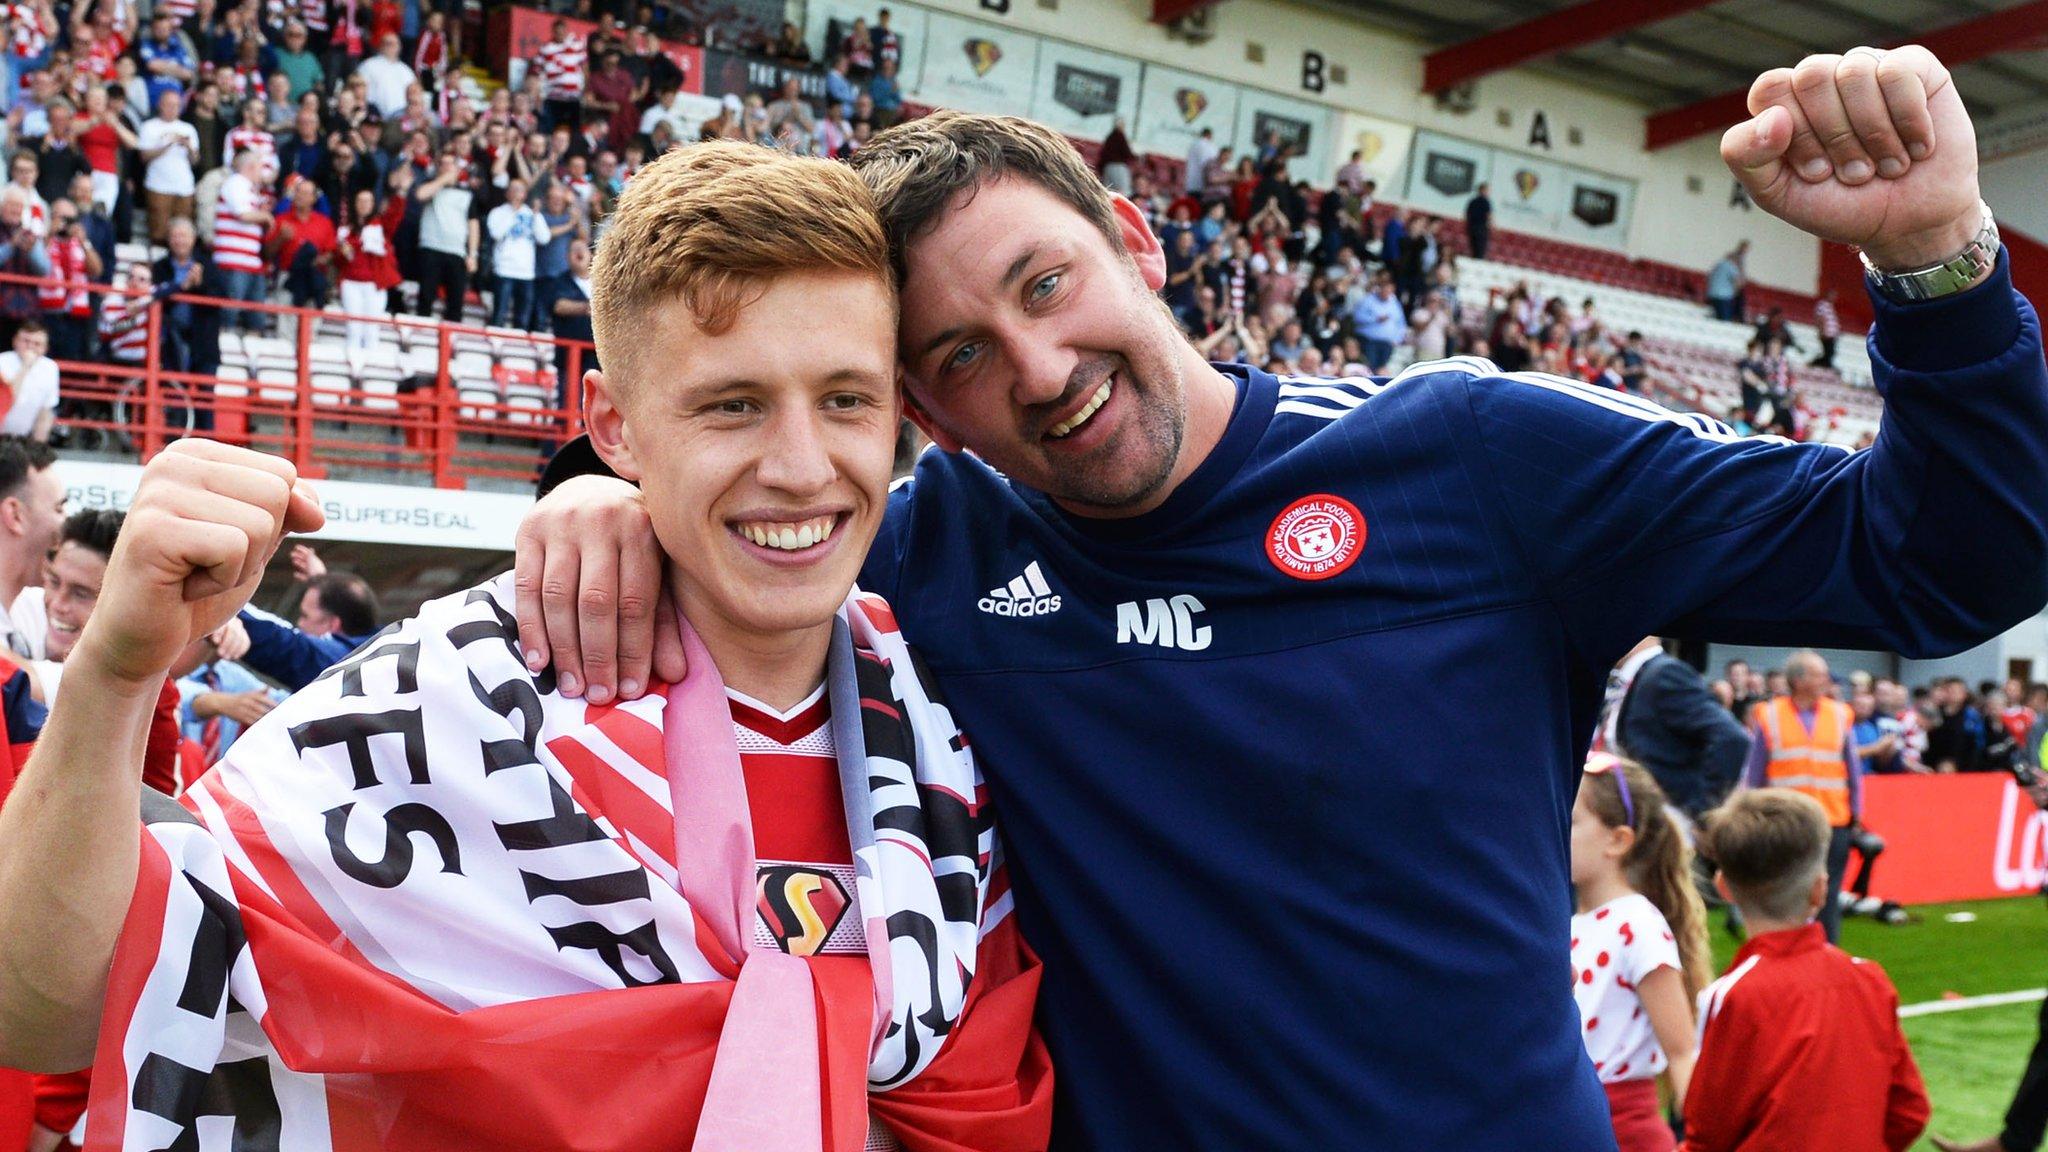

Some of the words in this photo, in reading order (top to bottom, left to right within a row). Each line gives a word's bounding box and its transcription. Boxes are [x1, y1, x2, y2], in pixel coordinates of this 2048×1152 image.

[1302, 50, 1324, 93] B
[1529, 110, 1552, 150] A
[1273, 502, 1322, 541] ACADEMICAL
[1323, 502, 1357, 537] FOOTBALL
[1272, 542, 1312, 573] HAMILTON
[1312, 560, 1335, 573] 1874
[1334, 539, 1356, 562] CLUB
[977, 595, 1061, 617] adidas
[1116, 594, 1212, 650] MC
